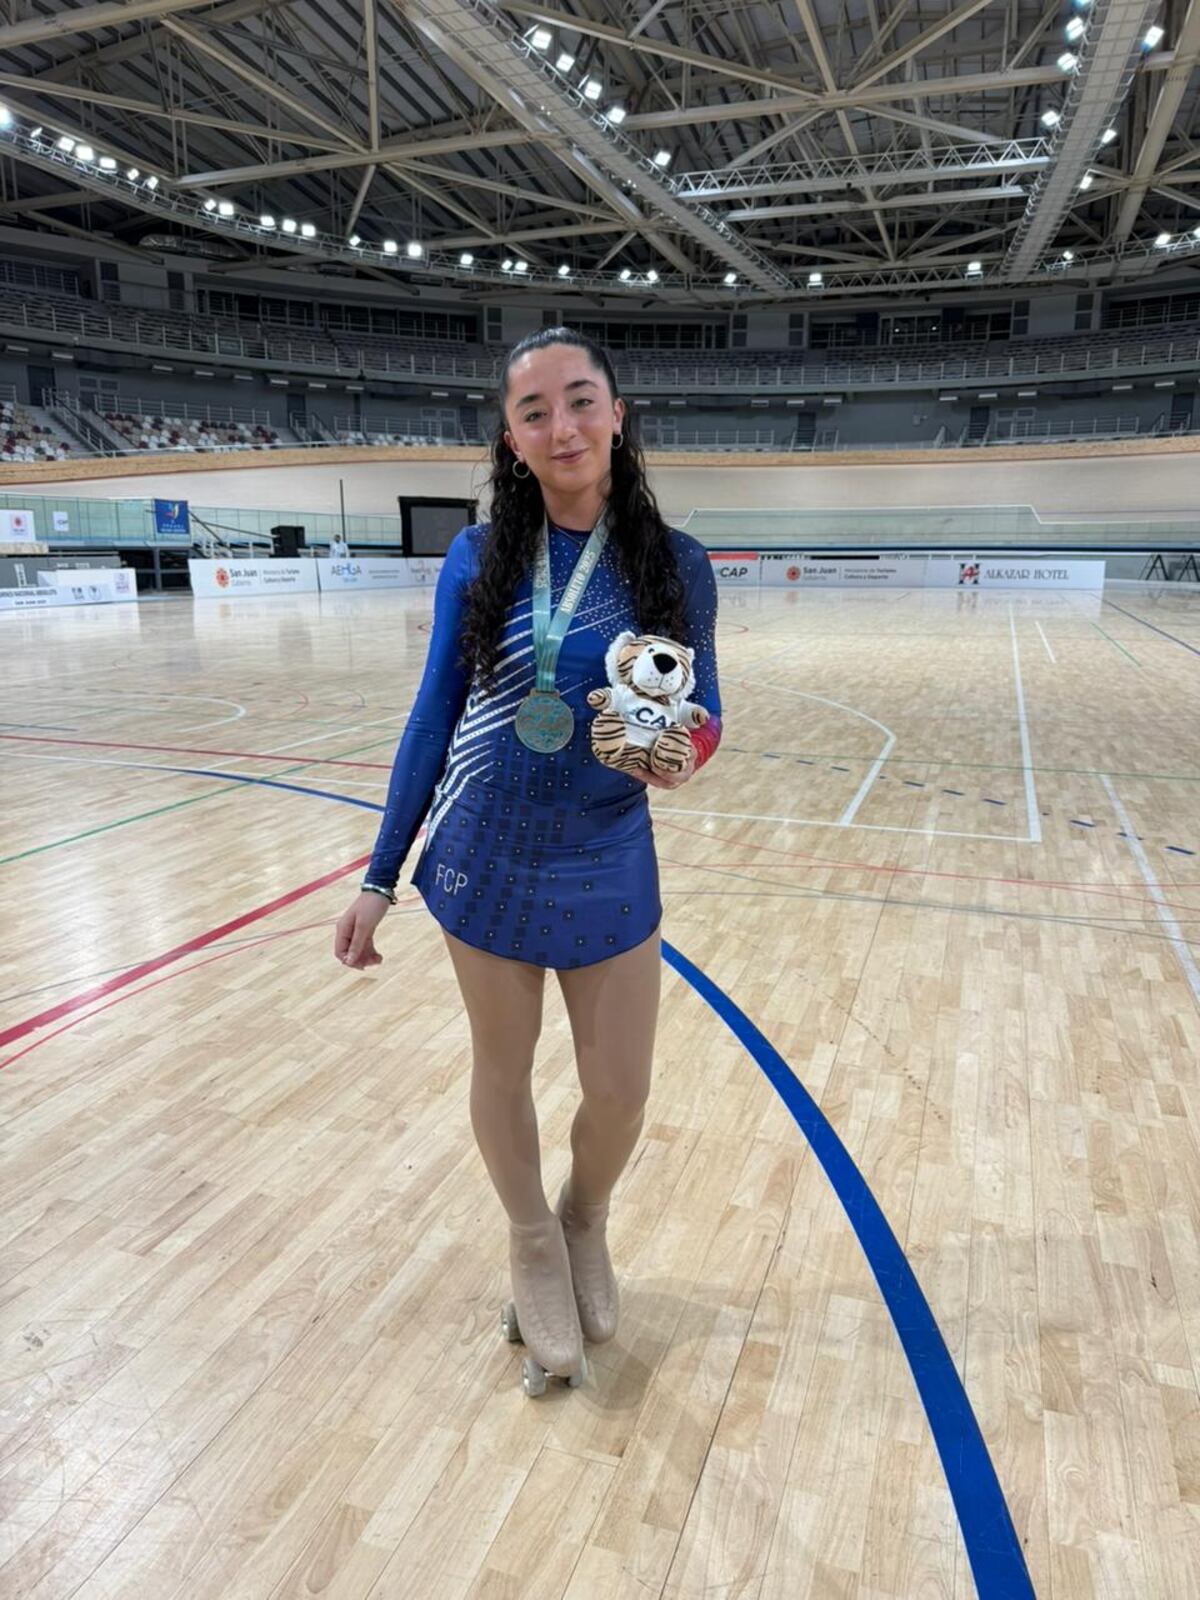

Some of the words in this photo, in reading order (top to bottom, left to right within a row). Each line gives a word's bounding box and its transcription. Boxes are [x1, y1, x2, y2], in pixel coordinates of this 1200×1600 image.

[579, 551, 596, 573] 2025
[229, 568, 242, 578] San
[243, 568, 258, 577] Juan
[720, 566, 748, 577] CAP
[803, 566, 817, 574] San
[819, 566, 837, 574] Juan
[984, 569, 1031, 580] ALKAZAR
[1033, 569, 1070, 580] HOTEL
[635, 706, 677, 730] CA
[435, 863, 468, 896] FCP
